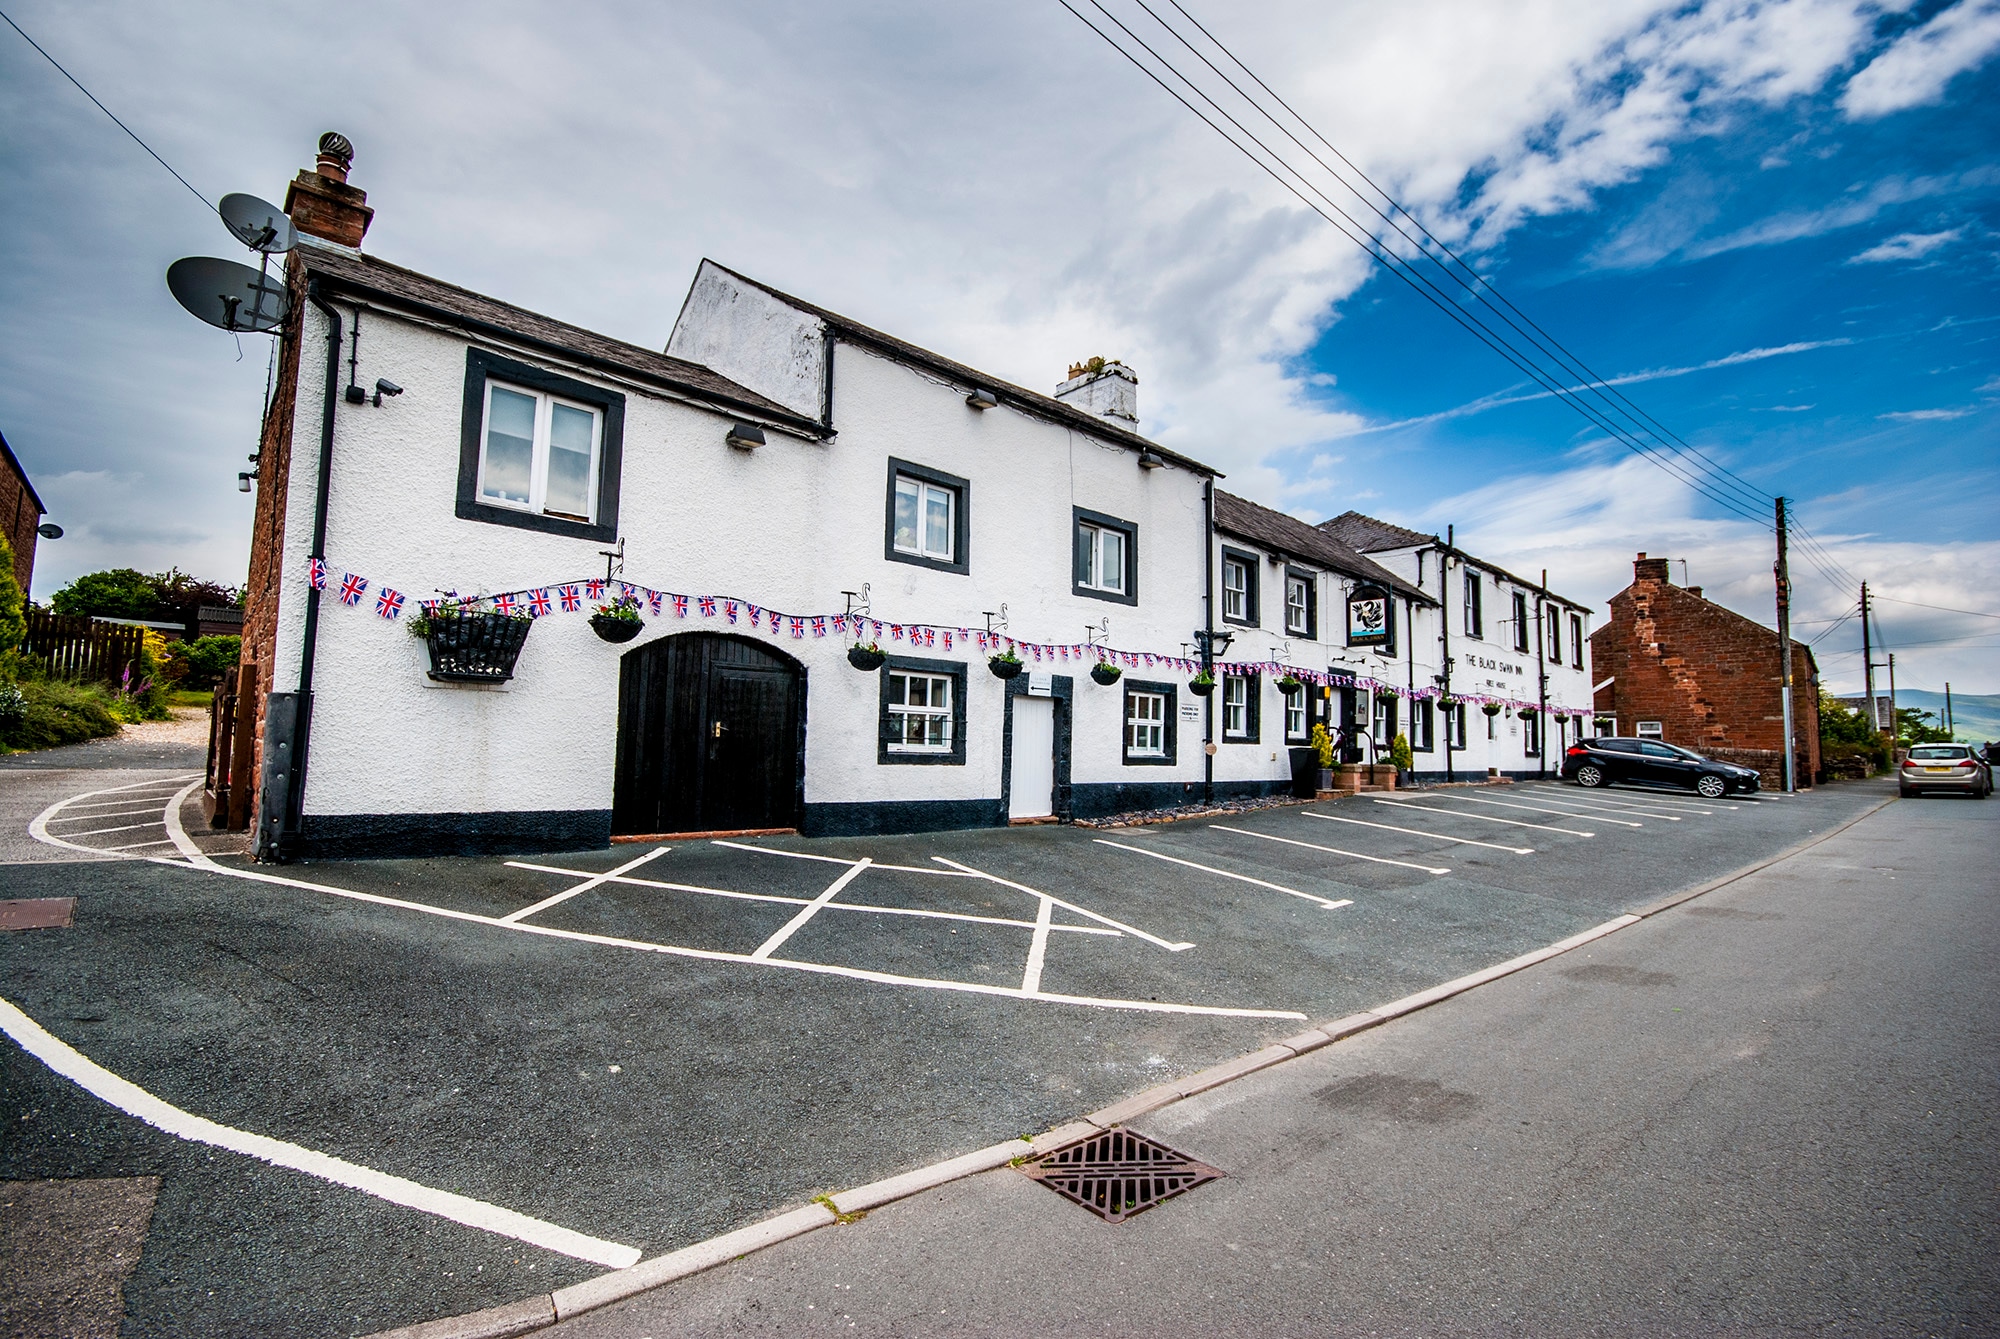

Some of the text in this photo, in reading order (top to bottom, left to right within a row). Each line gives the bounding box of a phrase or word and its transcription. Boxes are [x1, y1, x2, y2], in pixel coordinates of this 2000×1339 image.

[1466, 653, 1523, 675] THE BLACK SWAN INN
